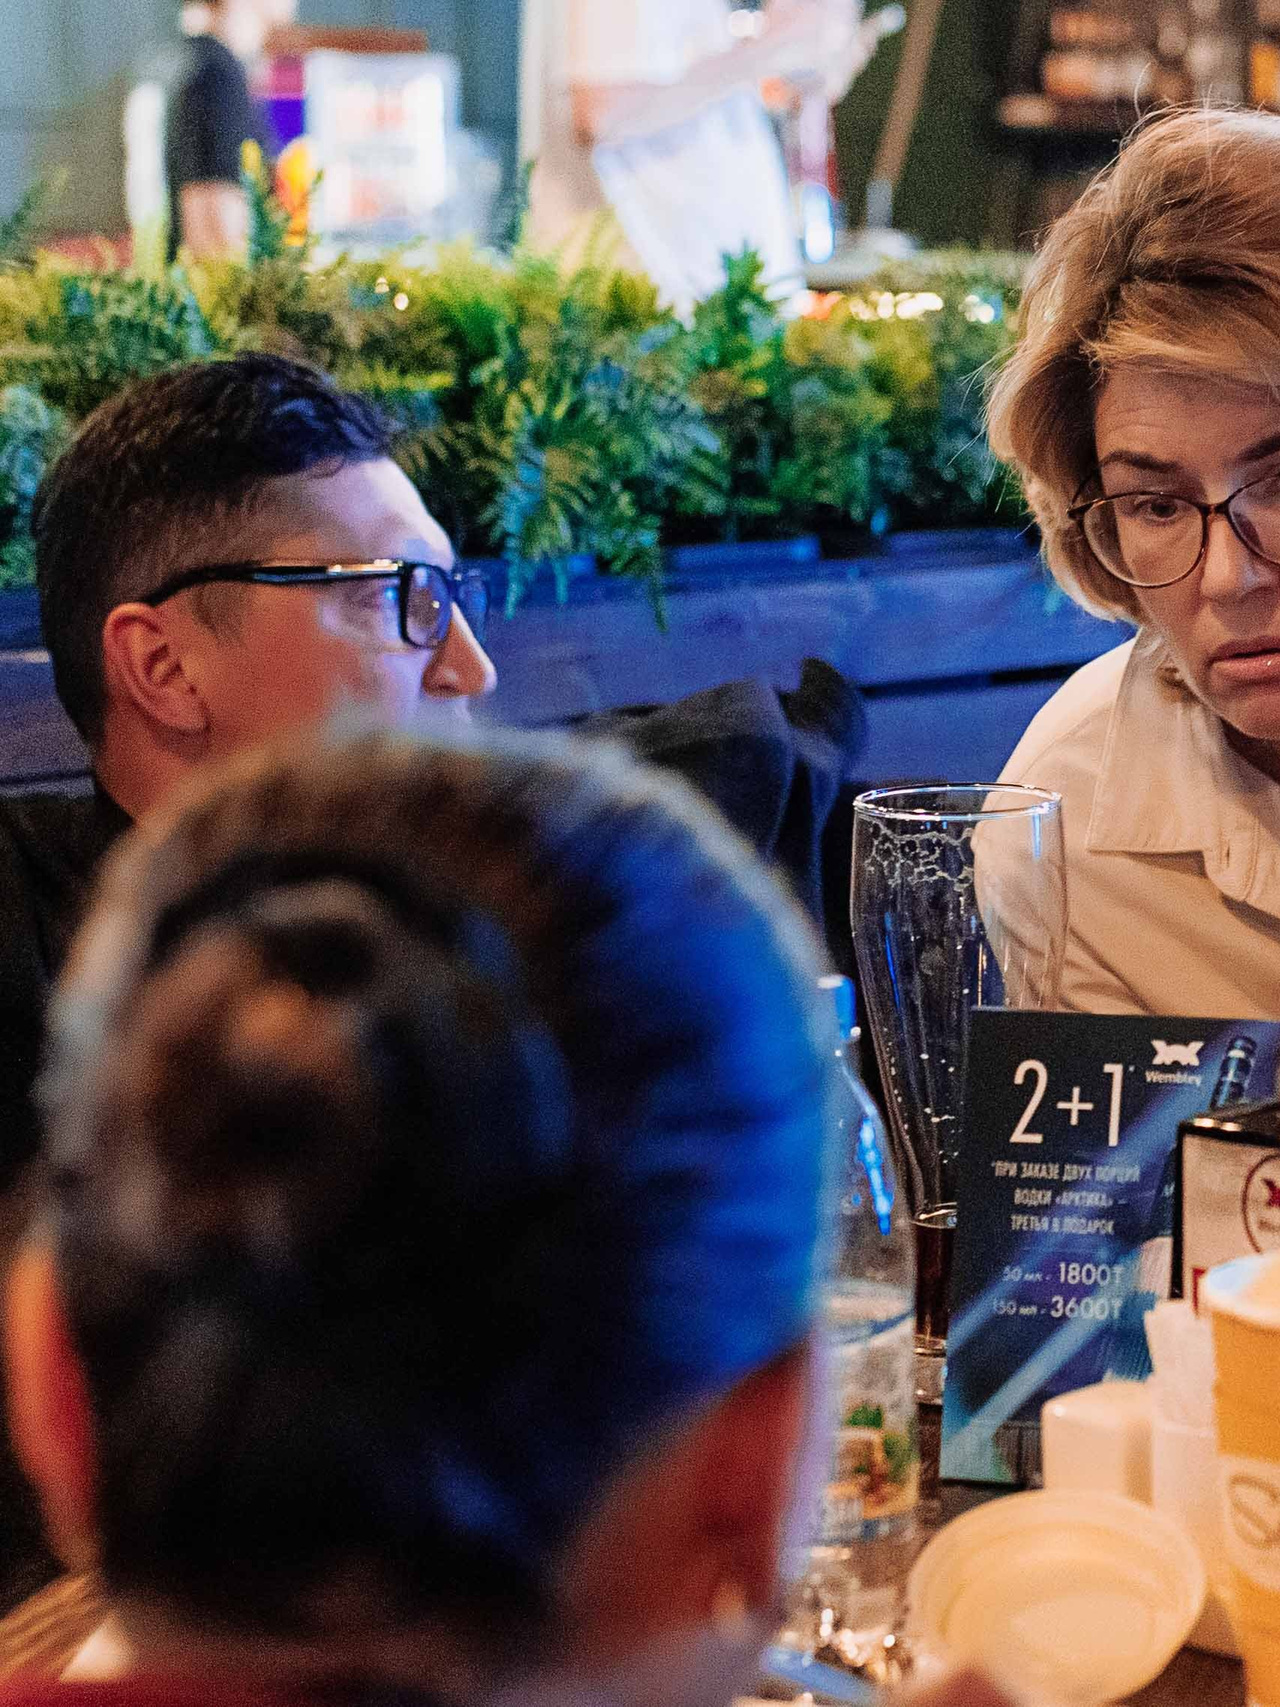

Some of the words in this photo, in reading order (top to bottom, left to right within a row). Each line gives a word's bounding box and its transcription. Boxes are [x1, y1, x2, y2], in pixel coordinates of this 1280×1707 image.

[1145, 1069, 1201, 1086] Wembley
[1020, 1161, 1060, 1179] ЗАКАЗЕ
[1062, 1163, 1093, 1182] ДВУХ
[1095, 1165, 1140, 1183] ПОРЦИЙ
[1014, 1188, 1052, 1207] ВОДКИ
[1011, 1214, 1049, 1231] ТРЕТЬЯ
[1063, 1216, 1115, 1234] ПОДАРОК
